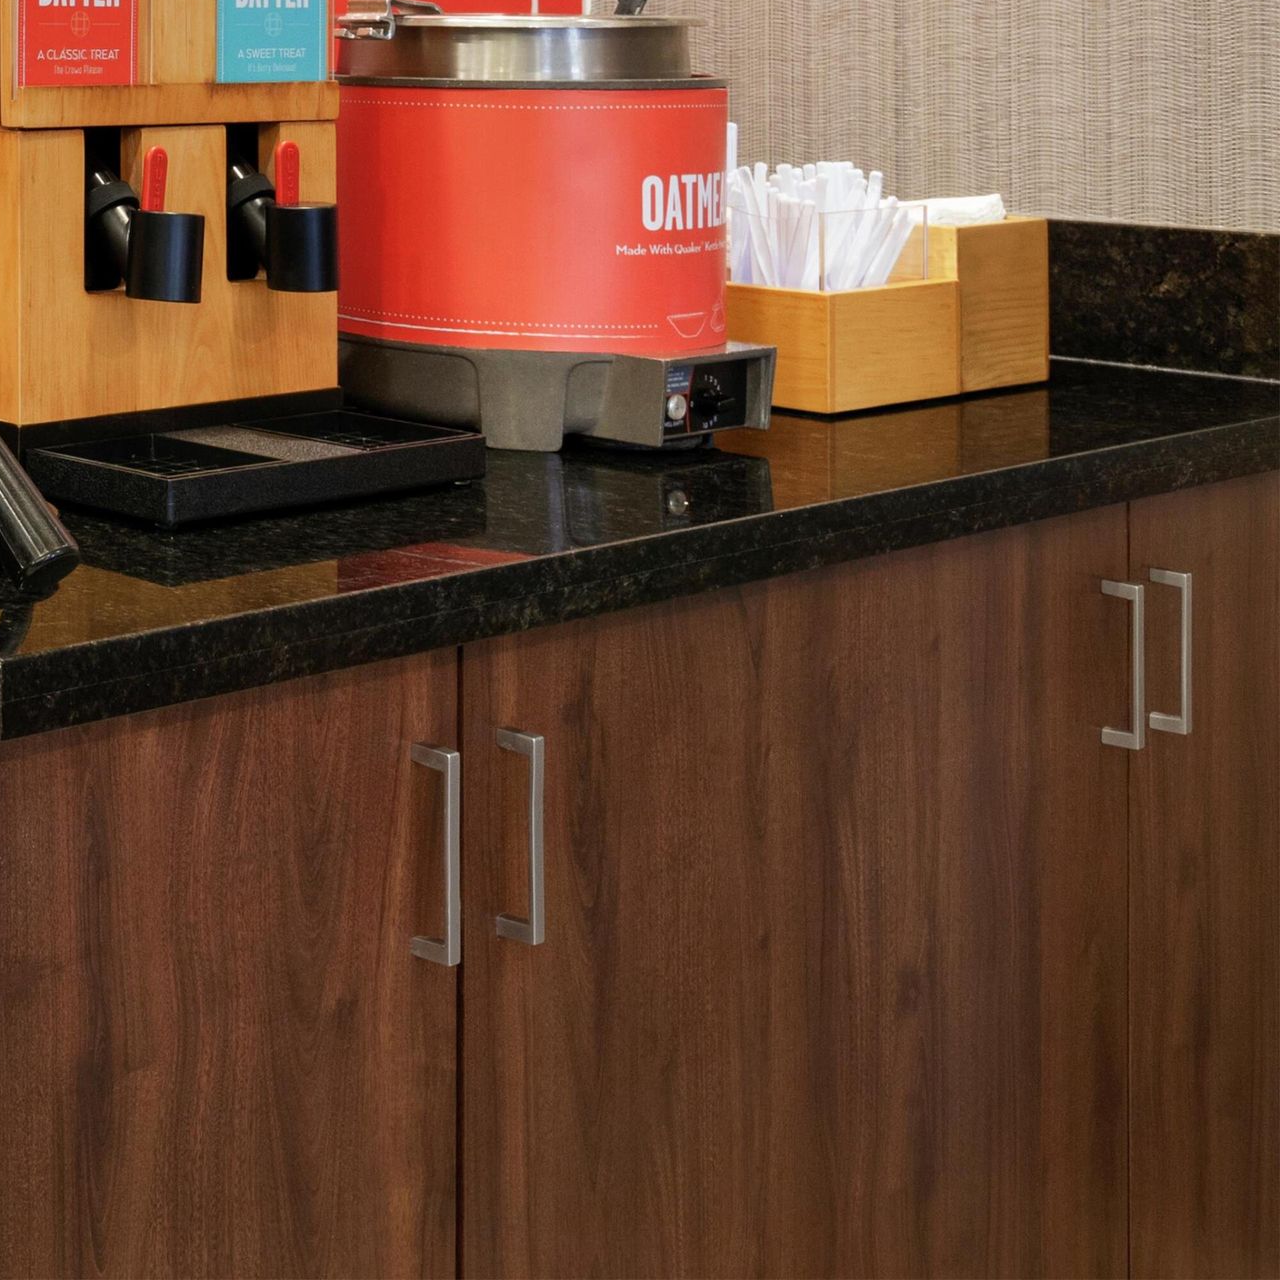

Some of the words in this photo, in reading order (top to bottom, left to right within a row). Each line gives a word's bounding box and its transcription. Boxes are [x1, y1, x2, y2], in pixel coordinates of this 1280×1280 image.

[37, 50, 45, 60] A
[46, 49, 88, 60] CLASSIC
[90, 49, 120, 60] TREAT
[238, 49, 245, 58] A
[246, 48, 277, 59] SWEET
[279, 47, 307, 58] TREAT
[615, 243, 647, 256] Made
[649, 242, 673, 255] With
[674, 242, 701, 254] Quaker
